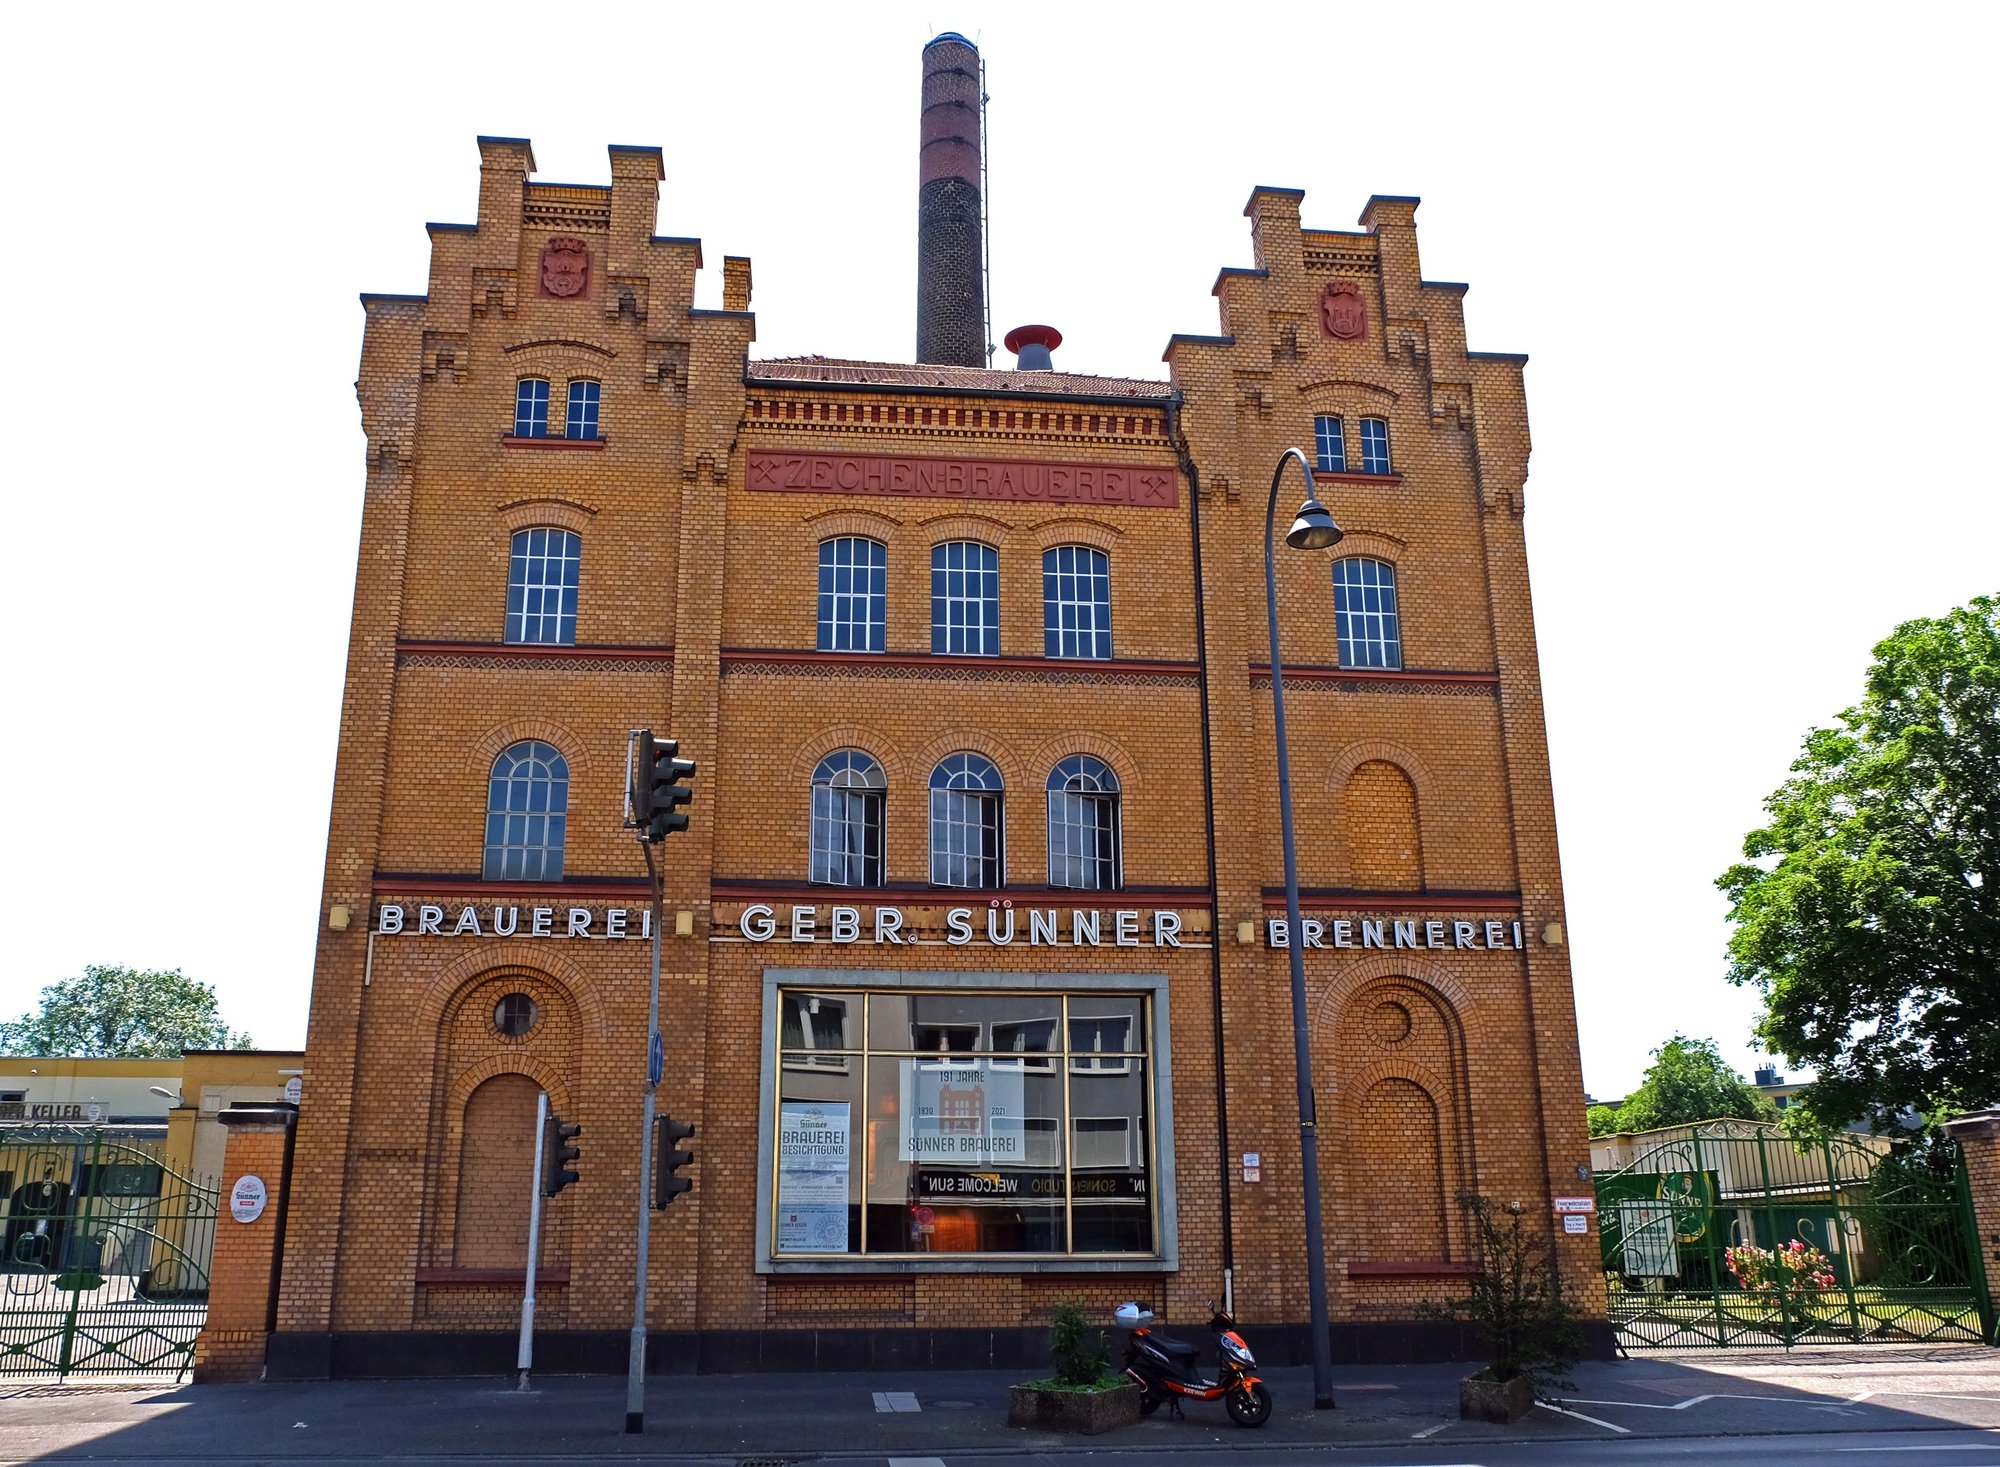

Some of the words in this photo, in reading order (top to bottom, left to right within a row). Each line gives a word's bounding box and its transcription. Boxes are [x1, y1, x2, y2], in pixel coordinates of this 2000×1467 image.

[379, 905, 650, 939] BRAUEREI
[740, 905, 918, 944] GEBR.
[947, 900, 1182, 947] SÜNNER
[1269, 920, 1523, 949] BRENNEREI
[940, 1071, 953, 1082] 191
[956, 1071, 985, 1082] JAHRE
[31, 1104, 81, 1119] KELLER
[918, 1107, 934, 1115] 1830
[991, 1107, 1006, 1115] 2021
[782, 1131, 845, 1144] BRAUEREI
[908, 1137, 955, 1152] SÜNNER
[960, 1137, 1016, 1152] BRAUEREI
[782, 1144, 845, 1155] BESICHTIGUNG
